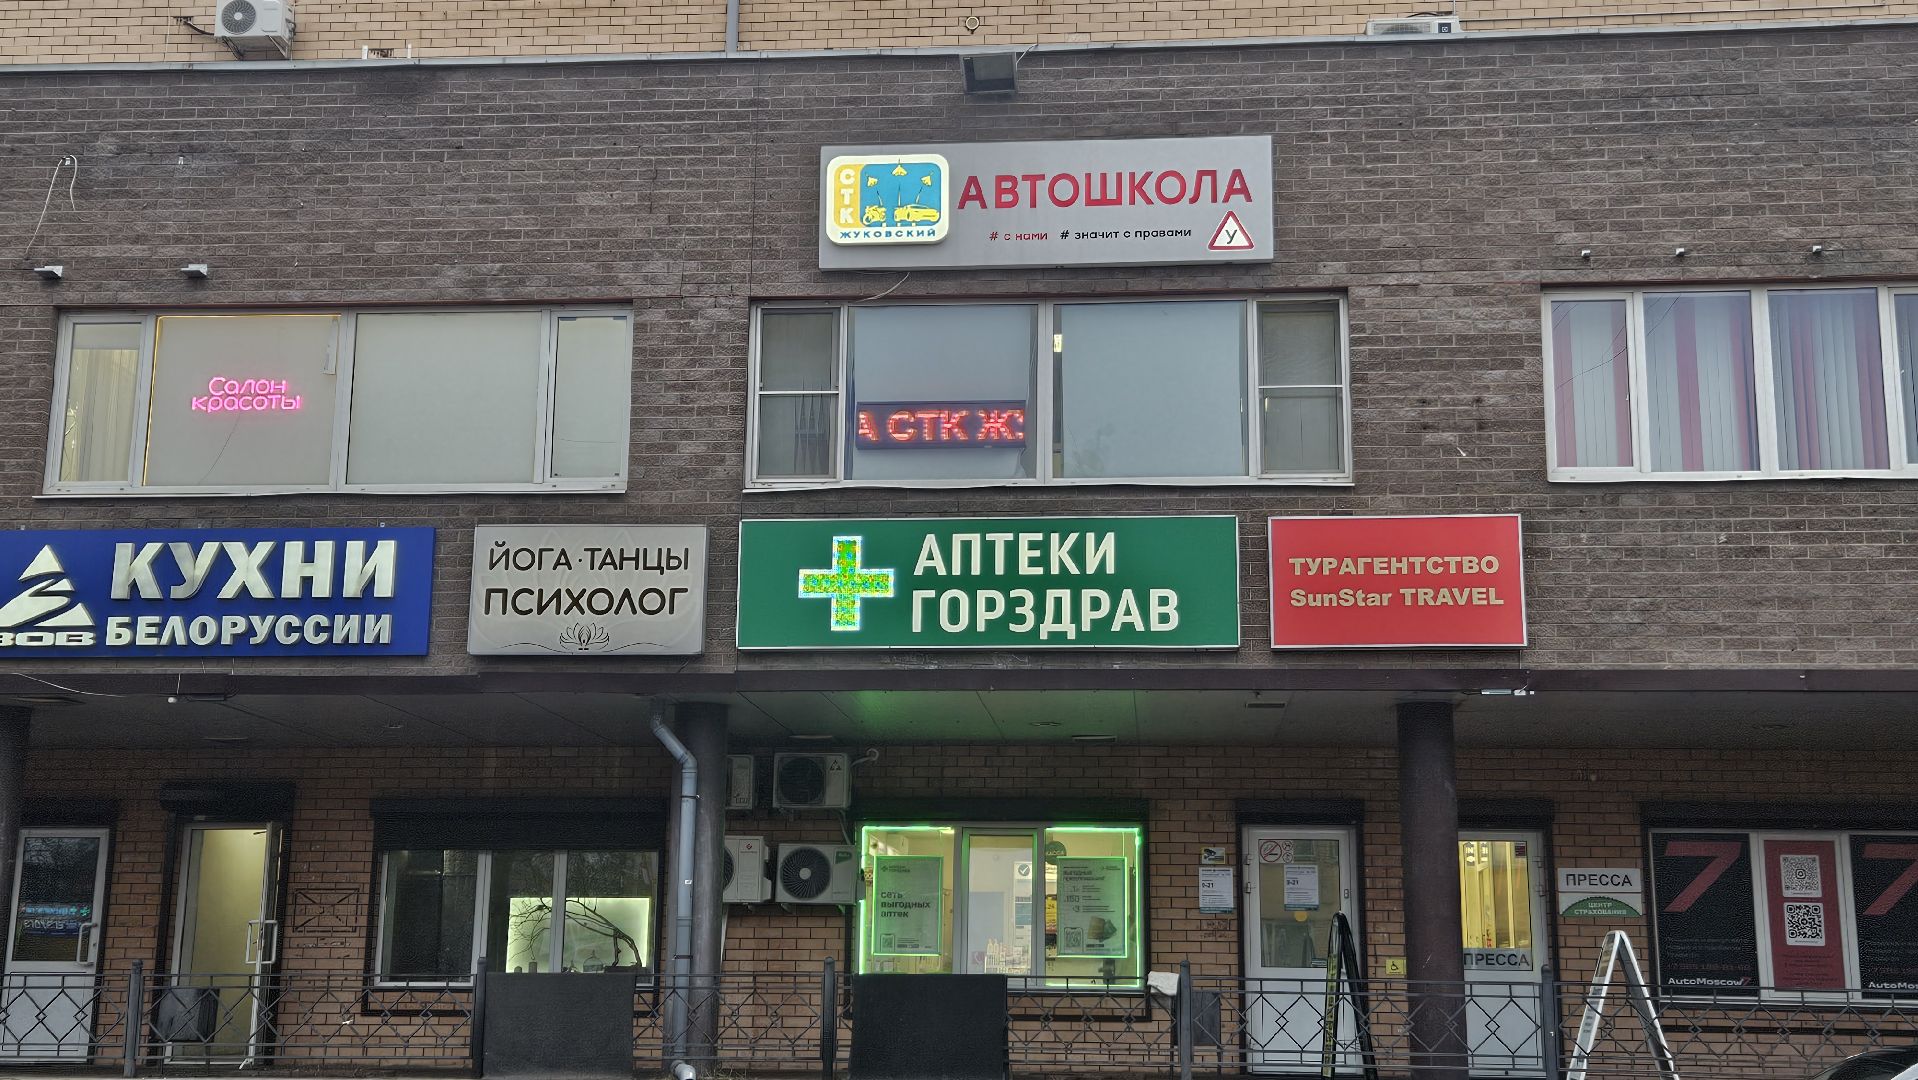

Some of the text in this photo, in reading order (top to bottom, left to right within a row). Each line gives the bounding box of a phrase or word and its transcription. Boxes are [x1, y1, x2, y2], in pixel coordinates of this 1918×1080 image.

[839, 168, 856, 224] СТК
[957, 168, 1253, 210] АВТОШКОЛА
[839, 228, 936, 239] ЖУКОВСКИЙ
[1014, 231, 1049, 241] нами
[1074, 230, 1120, 240] значит
[1134, 227, 1192, 240] правами
[208, 376, 288, 396] Салон
[191, 394, 302, 413] красоты
[887, 409, 969, 441] СТК
[110, 540, 397, 600] КУХНИ
[488, 541, 690, 576] ЙОГА ТАНЦЫ
[913, 532, 1115, 577] АПТЕКИ
[1288, 555, 1500, 576] ТУРАГЕНТСТВО
[484, 586, 690, 616] ПСИХОЛОГ
[1290, 587, 1505, 607] SunStar TRAVEL
[911, 588, 1180, 640] ГОРЗДРАВ
[105, 614, 393, 646] БЕЛОРУССИИ
[1565, 873, 1633, 887] ПРЕССА
[1664, 841, 1742, 913] 7
[1463, 953, 1530, 966] ПРЕССА
